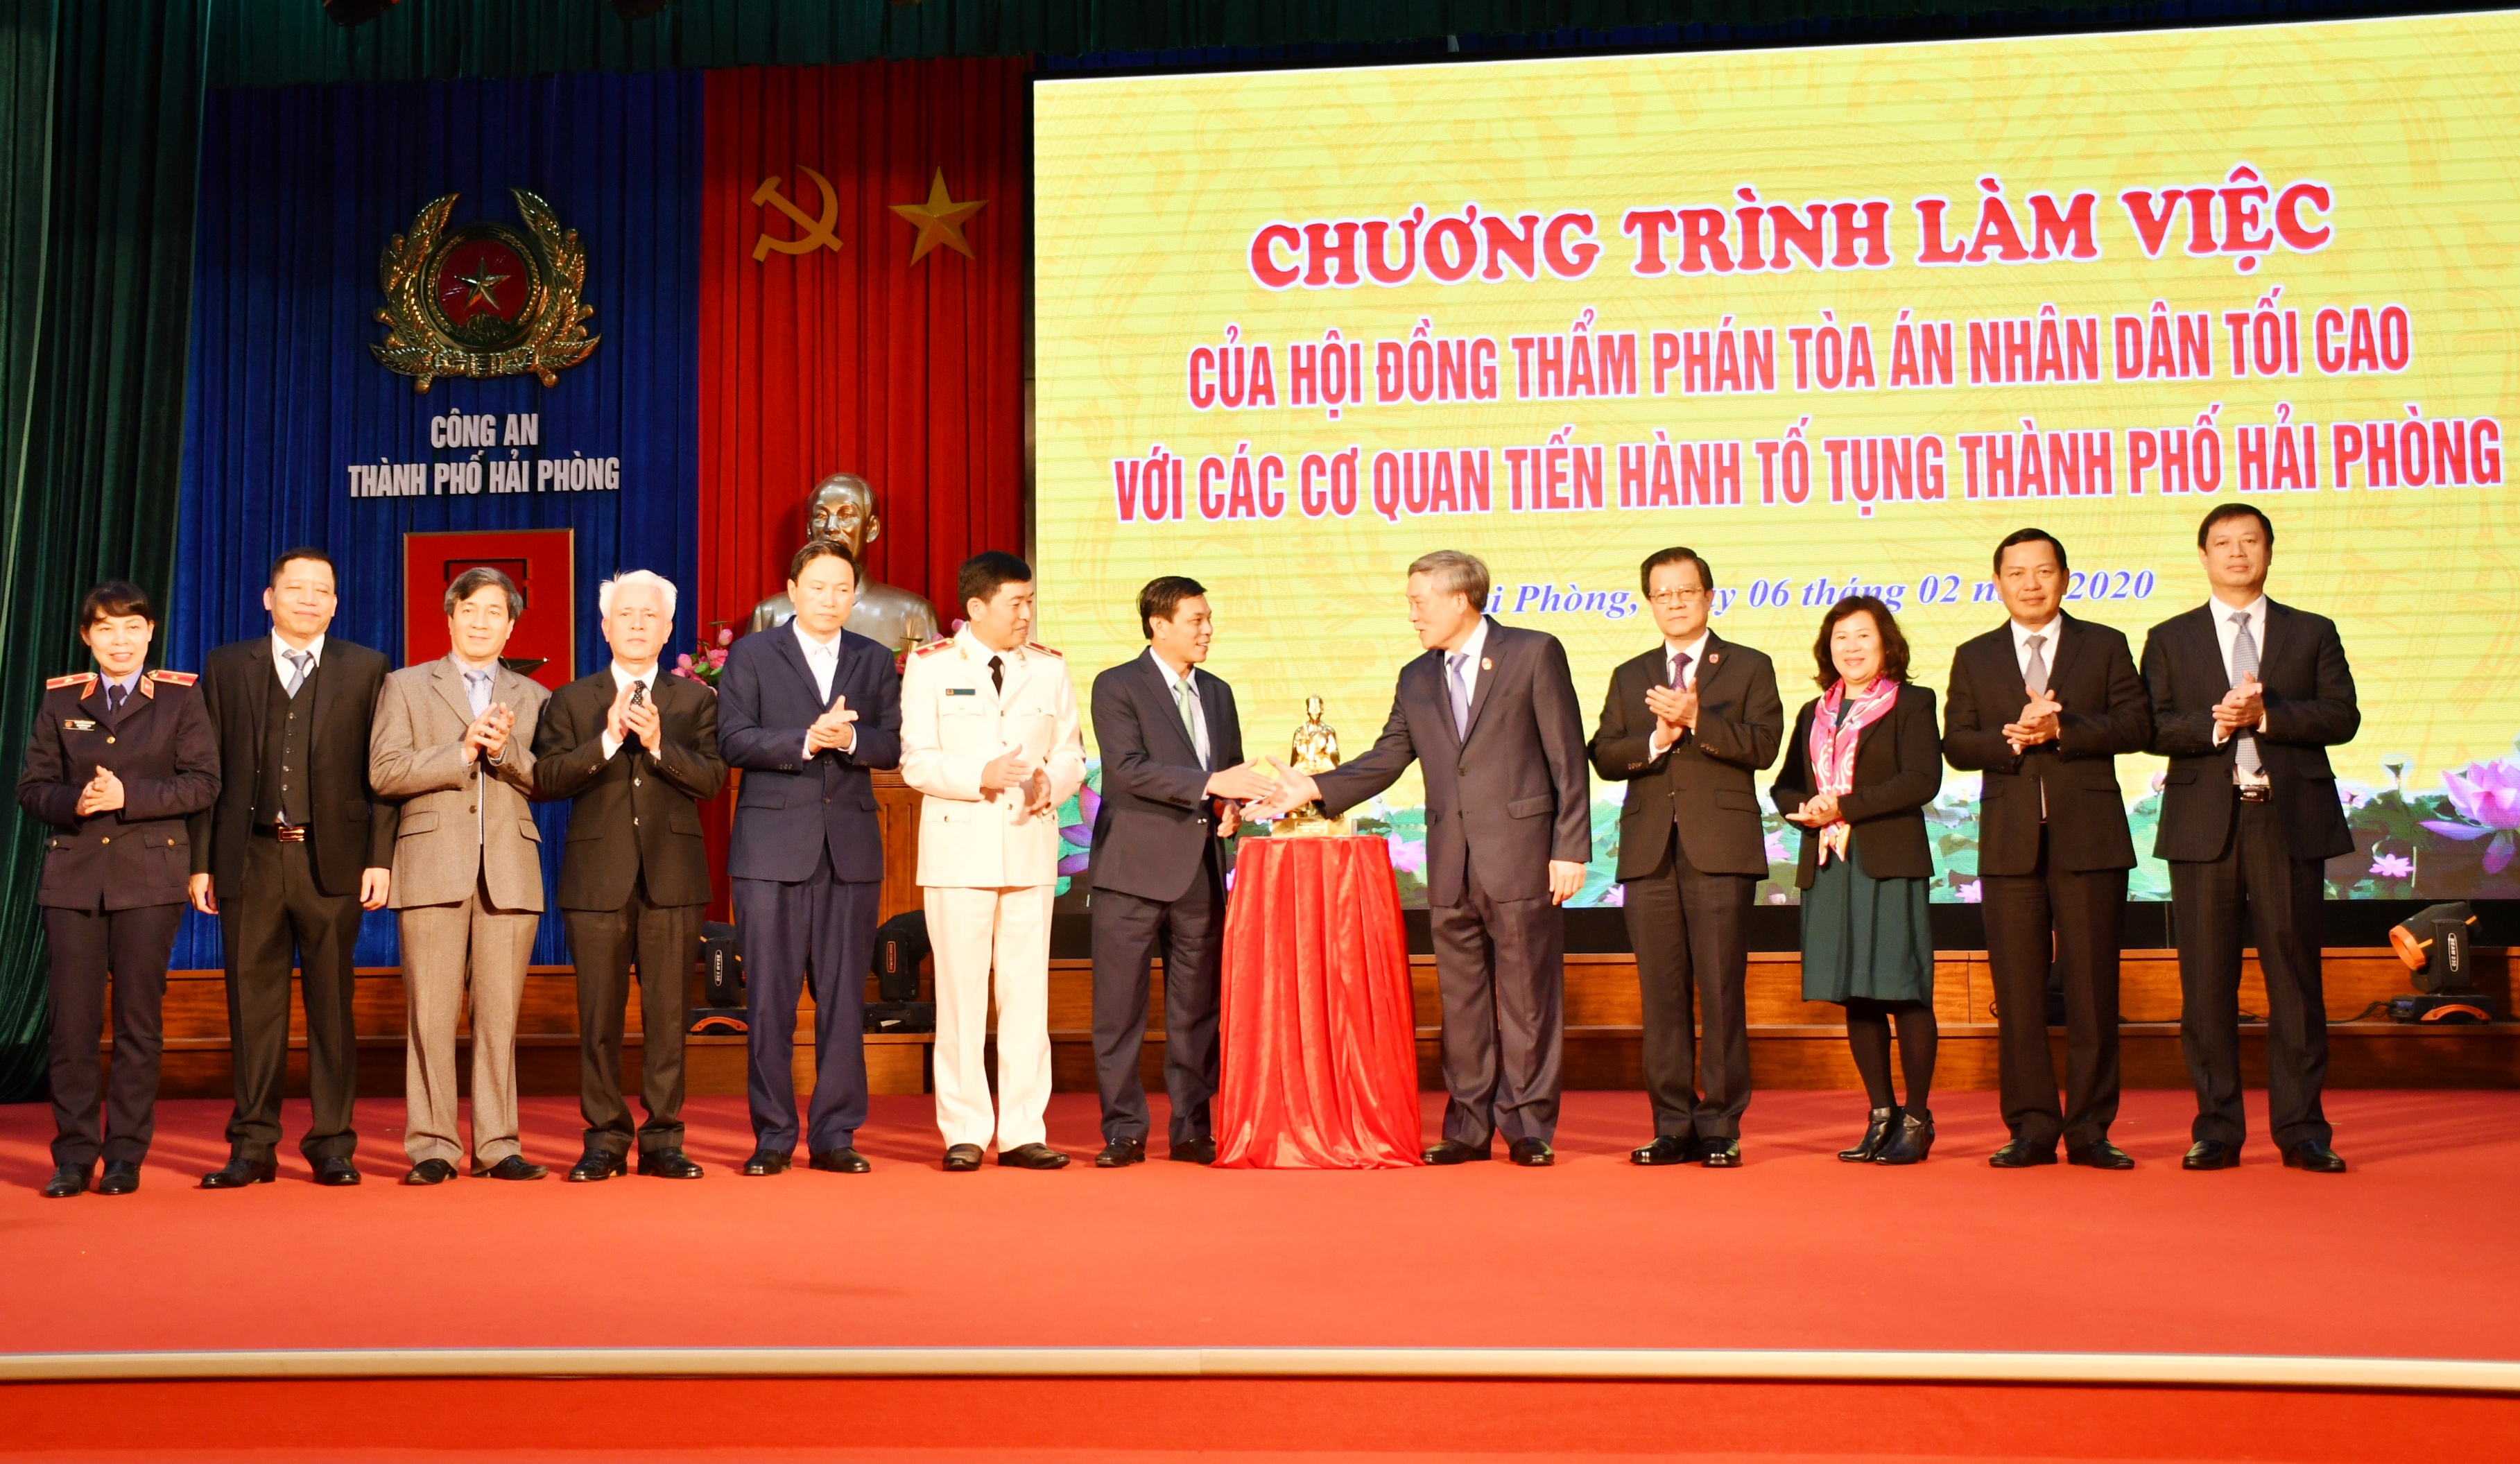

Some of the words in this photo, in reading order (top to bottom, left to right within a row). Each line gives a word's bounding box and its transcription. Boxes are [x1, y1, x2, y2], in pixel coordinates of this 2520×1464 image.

[1252, 205, 1600, 286] CHƯƠNG
[1625, 187, 1890, 273] TRÌNH
[1917, 178, 2098, 262] LÀM
[2123, 166, 2331, 270] VIỆC
[1190, 325, 1275, 408] CỦA
[1291, 330, 1361, 418] HỘI
[1376, 318, 1496, 401] ĐỒNG
[1512, 309, 1637, 397] THẨM
[1654, 317, 1775, 393] PHÁN
[1789, 311, 1876, 388] TÒA
[1892, 311, 1953, 386] ÁN
[1970, 305, 2098, 383] NHÂN
[2116, 302, 2211, 378] DÂN
[2226, 287, 2299, 374] TỐI
[2317, 307, 2409, 372] CAO
[431, 408, 497, 449] CÔNG
[503, 413, 539, 446] AN
[1115, 446, 1182, 520] VỚI
[1200, 444, 1284, 519] CÁC
[1302, 447, 1358, 516] CƠ
[1374, 451, 1490, 520] QUAN
[1505, 427, 1603, 509] TIẾN
[1621, 431, 1741, 506] HÀNH
[1757, 417, 1809, 503] TỐ
[1825, 436, 1944, 515] TỤNG
[1960, 420, 2112, 497] THÀNH
[2130, 404, 2220, 493] PHỐ
[2239, 403, 2317, 490] HẢI
[2334, 406, 2501, 488] PHÒNG
[347, 457, 427, 498] THÀNH
[434, 449, 483, 495] PHỐ
[489, 449, 530, 494] HẢI
[537, 451, 620, 492] PHÒNG
[1512, 584, 1637, 619] Phòng,
[1749, 578, 1790, 608] 06
[1918, 574, 1961, 603] 02
[2064, 570, 2155, 601] 2020
